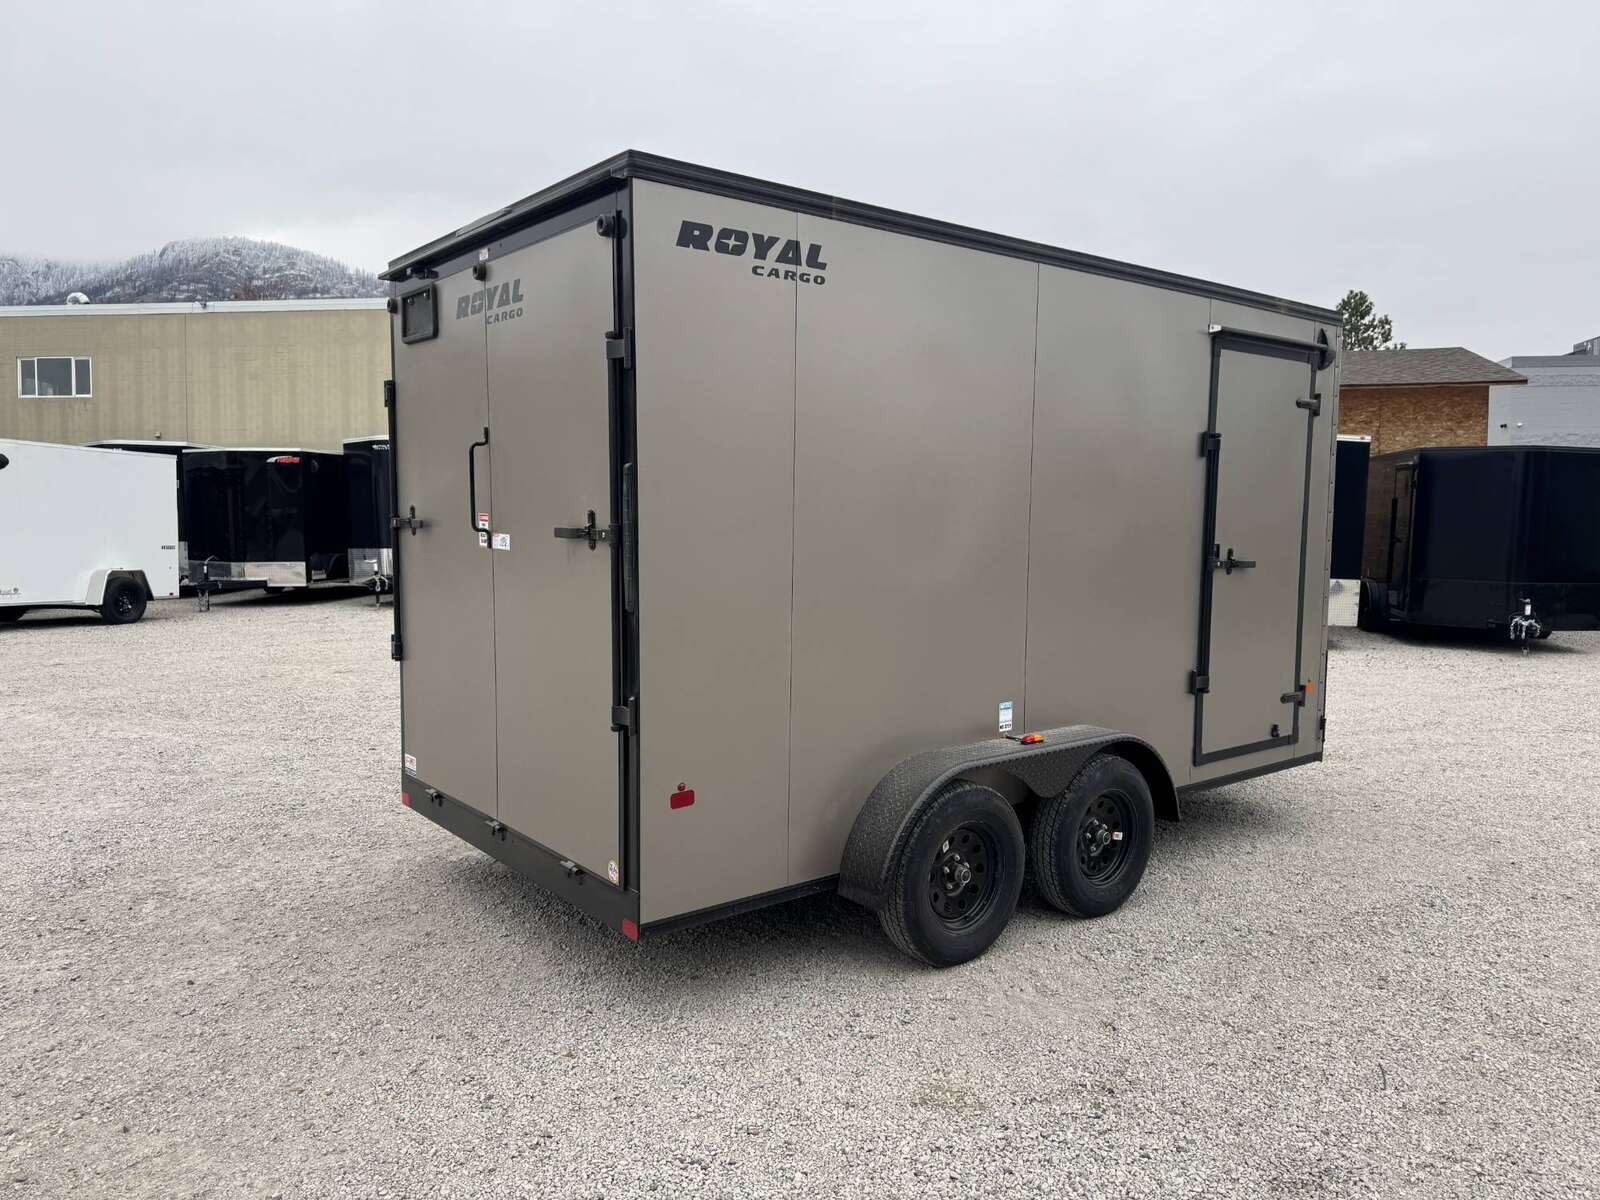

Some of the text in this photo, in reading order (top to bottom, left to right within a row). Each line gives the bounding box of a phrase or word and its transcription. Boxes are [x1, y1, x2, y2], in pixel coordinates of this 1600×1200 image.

[676, 220, 827, 270] ROYAL
[751, 265, 826, 285] CARGO
[456, 279, 524, 320] ROYAL
[486, 307, 523, 325] CARGO
